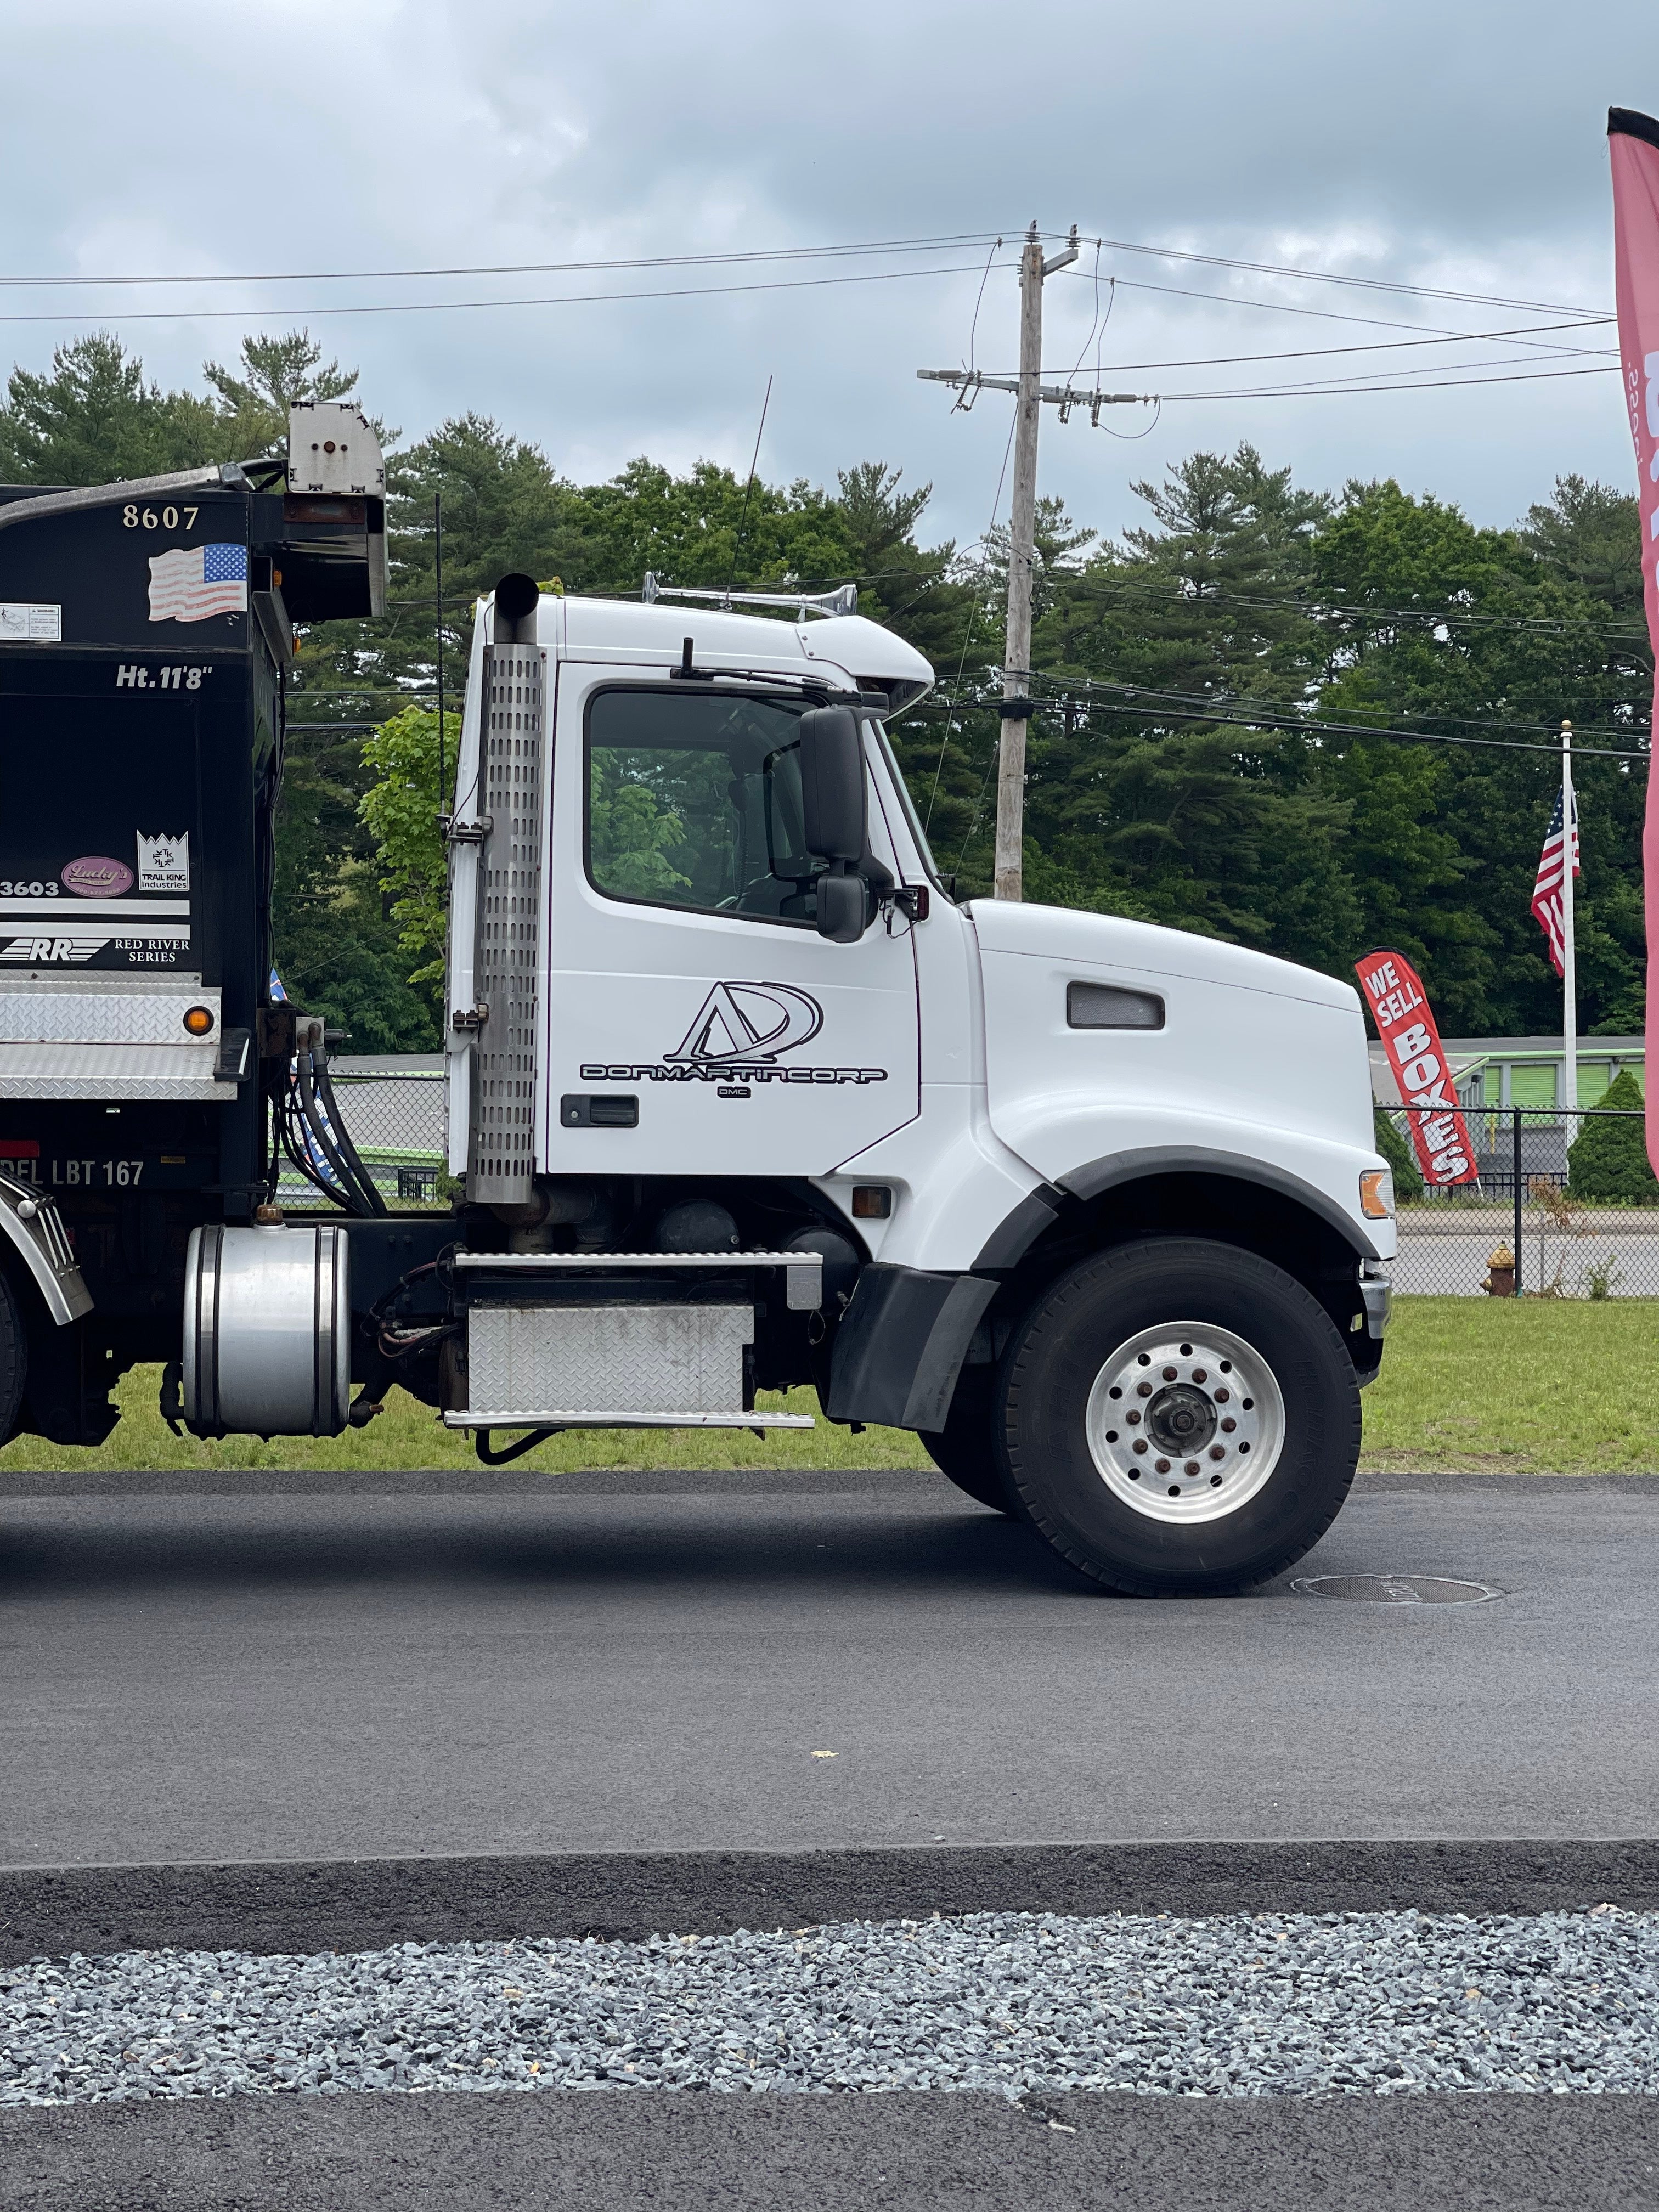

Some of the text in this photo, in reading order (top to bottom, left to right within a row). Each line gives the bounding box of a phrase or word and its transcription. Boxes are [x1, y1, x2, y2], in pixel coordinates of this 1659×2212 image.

[122, 505, 199, 530] 8607
[69, 865, 128, 885] Lucky's
[0, 881, 59, 896] 3603
[29, 938, 72, 961] RR
[115, 939, 190, 950] RED RIVER
[129, 952, 176, 962] SERIES
[1365, 960, 1400, 1000] WE
[1377, 981, 1423, 1028] SELL
[719, 1088, 748, 1096] DMC
[1392, 1023, 1470, 1183] BOXES
[52, 1160, 95, 1185] LBT
[103, 1160, 144, 1186] 167
